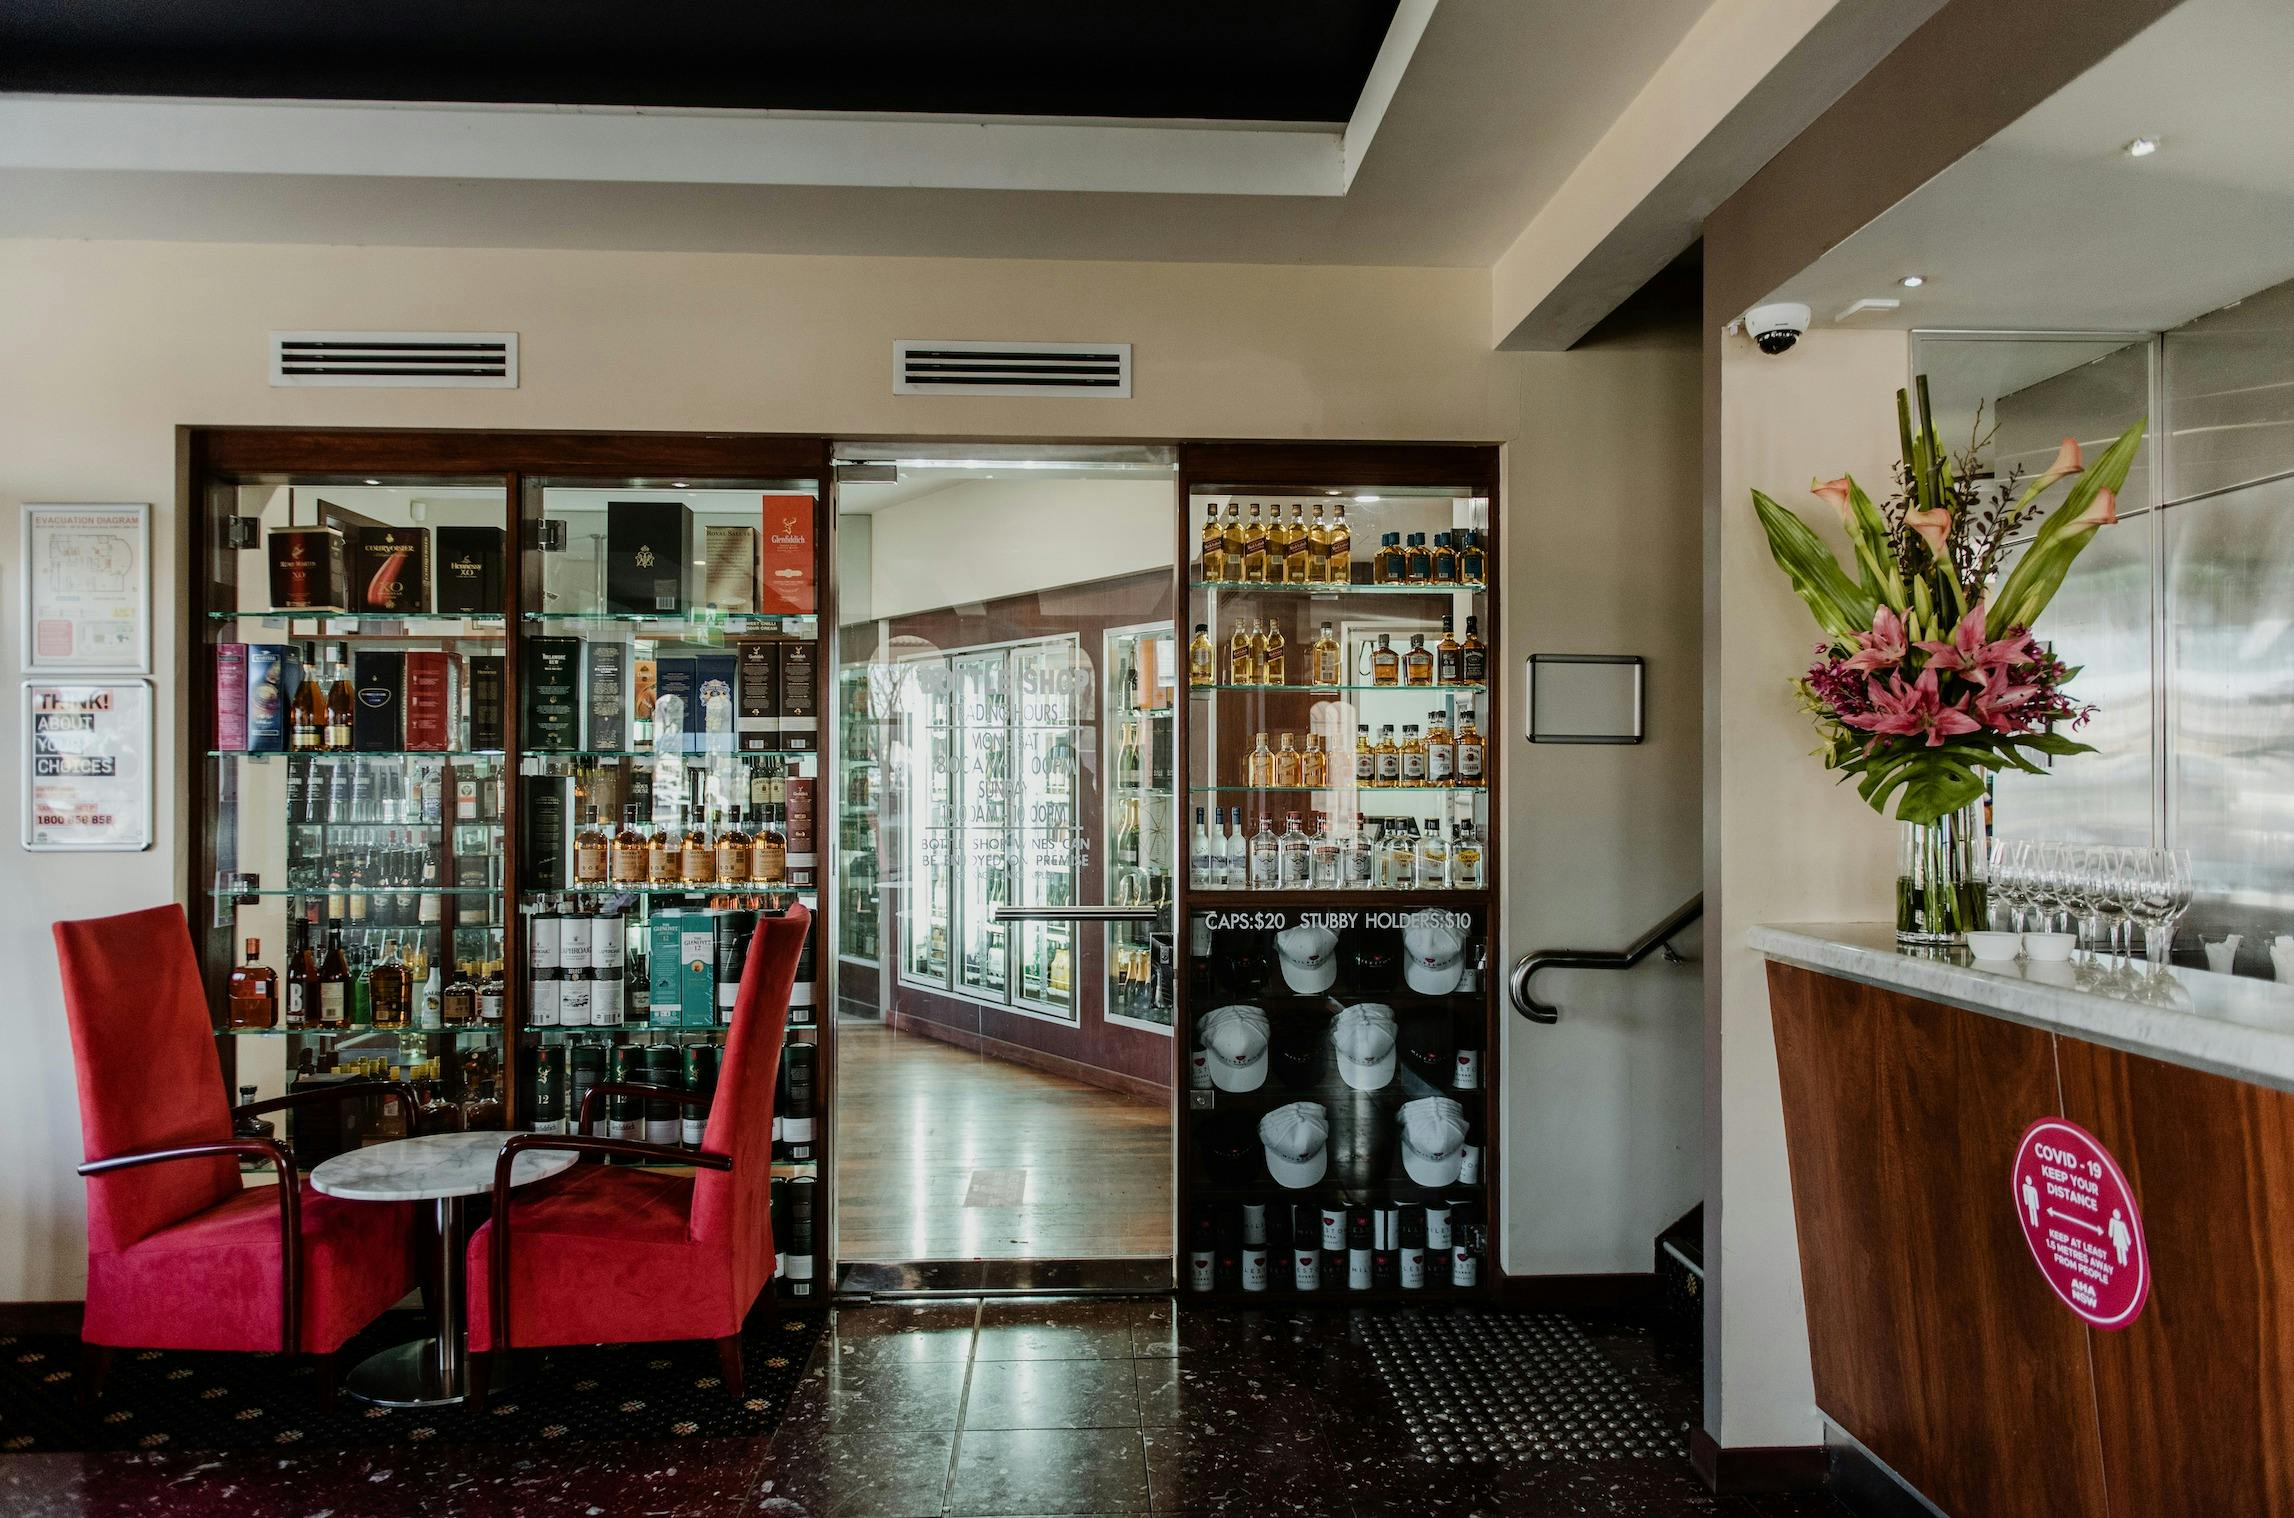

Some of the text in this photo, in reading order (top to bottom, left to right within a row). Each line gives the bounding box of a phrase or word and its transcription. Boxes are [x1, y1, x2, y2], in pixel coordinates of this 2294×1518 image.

[35, 516, 139, 525] EVACUATION DIAGRAM
[772, 535, 805, 544] Glenfiddich
[1023, 669, 1090, 695] SHOP
[1014, 704, 1058, 722] HOURS
[38, 716, 92, 731] ABOUT
[38, 759, 112, 774] CHOICES
[978, 780, 1027, 799] SUNDAY
[38, 815, 64, 825] 1800
[1014, 838, 1055, 850] WNES
[1062, 838, 1090, 850] CAN
[922, 854, 937, 866] BE
[944, 854, 1002, 866] ENOYED
[1036, 854, 1089, 866] PREMISE
[1205, 911, 1472, 931] CAPS:$20 STUBBY HOLDERS:$10
[290, 983, 303, 1012] B
[538, 1094, 550, 1104] 12
[617, 1094, 627, 1104] 12
[2034, 1142, 2078, 1169] COVID
[2087, 1160, 2103, 1179] 19
[2041, 1164, 2099, 1196] KEEP YOUR
[2046, 1182, 2099, 1212] DISTANCE
[2049, 1228, 2108, 1260] KEEP AT LEAST
[2057, 1243, 2089, 1263] METRES
[2090, 1257, 2114, 1275] AWAY
[2053, 1253, 2109, 1285] FROM PEOPLE
[2071, 1278, 2097, 1297] AHA
[2071, 1289, 2098, 1309] NSW
